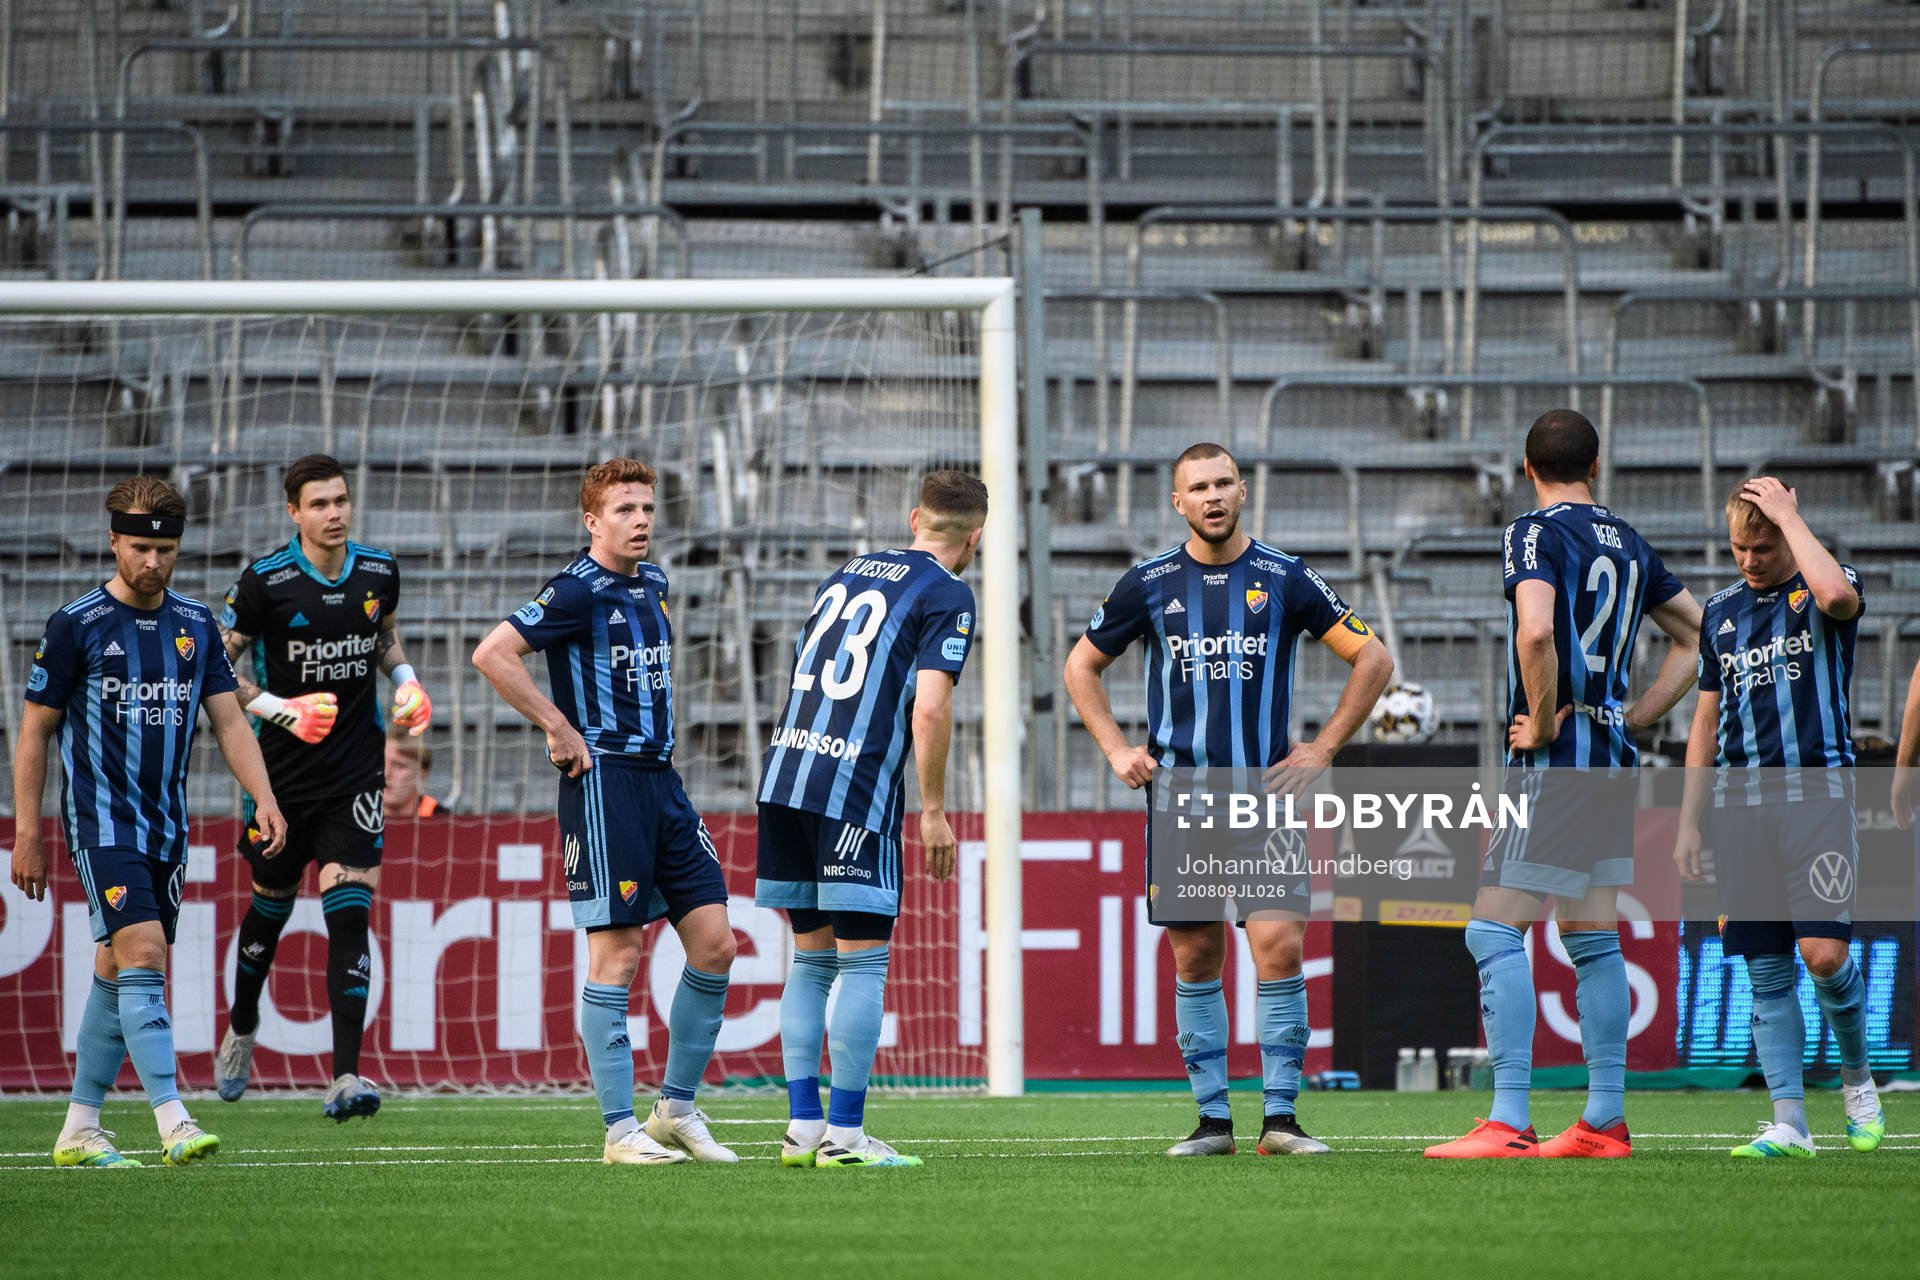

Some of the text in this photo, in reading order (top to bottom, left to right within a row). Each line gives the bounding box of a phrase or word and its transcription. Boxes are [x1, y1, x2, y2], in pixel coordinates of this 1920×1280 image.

[1592, 523, 1622, 549] BERG
[1142, 564, 1181, 582] WELLNESS
[1146, 562, 1173, 575] NORDIC
[1250, 560, 1286, 576] WELLNESS
[1256, 557, 1282, 569] NORDIC
[1203, 573, 1228, 581] Prioritet
[1580, 555, 1638, 673] 21
[288, 632, 378, 662] Prioritet
[792, 583, 887, 700] 23
[1166, 630, 1267, 659] Prioritet
[1719, 629, 1813, 677] Prioritet
[301, 659, 367, 683] Finans
[1180, 658, 1253, 683] Finans
[1733, 662, 1801, 697] Finans
[101, 677, 192, 702] Prioritet
[116, 702, 183, 726] Finans
[770, 726, 864, 764] LANDSSON
[823, 865, 872, 880] NRC Group
[568, 880, 588, 892] Group
[1395, 906, 1457, 920] DHL
